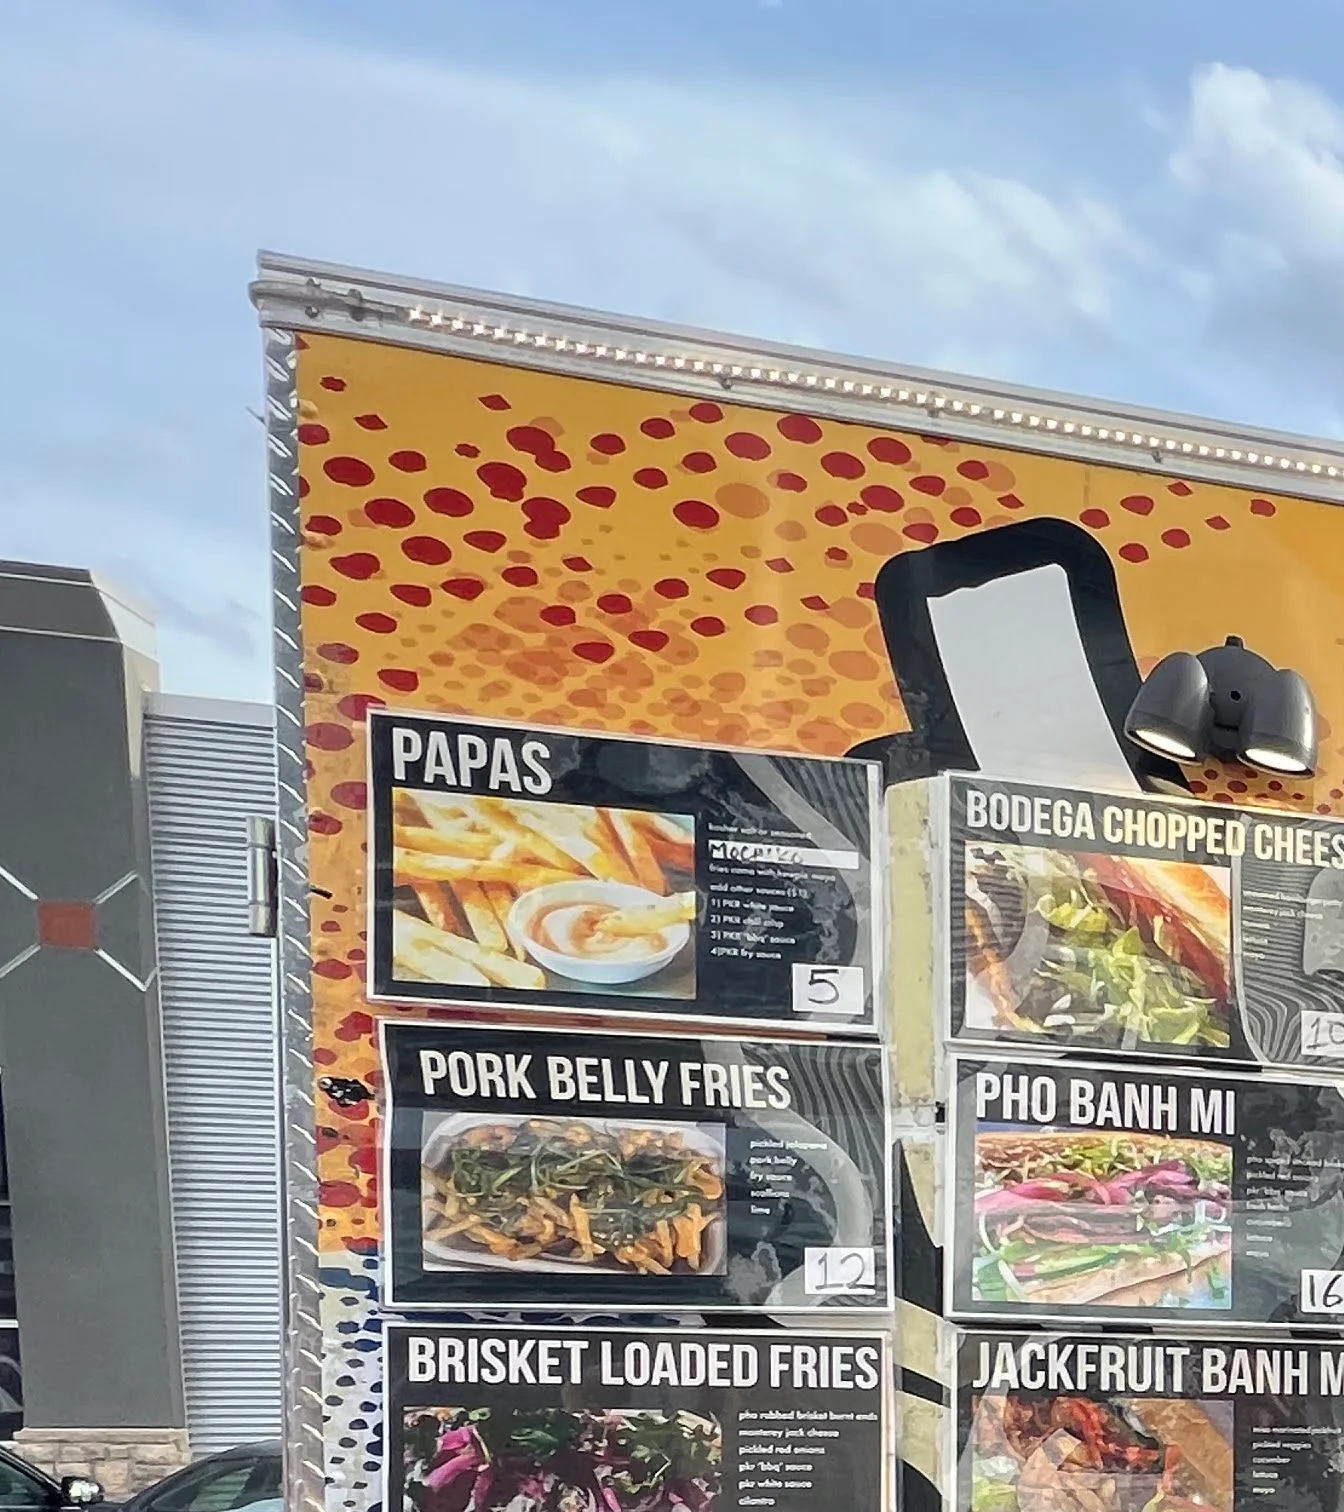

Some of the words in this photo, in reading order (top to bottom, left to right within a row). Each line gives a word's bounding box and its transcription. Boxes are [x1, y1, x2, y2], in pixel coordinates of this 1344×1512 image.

[392, 726, 553, 795] PAPAS
[965, 789, 1095, 841] BODEGA
[1103, 805, 1246, 856] CHOPPED
[808, 969, 839, 1004] 5
[419, 1049, 536, 1100] PORK
[548, 1055, 668, 1106] BELLY
[681, 1062, 792, 1110] FRIES
[975, 1072, 1057, 1123] PHO
[1069, 1078, 1177, 1132] BANH
[1190, 1087, 1236, 1135] MI
[815, 1252, 875, 1290] 12
[1307, 1274, 1344, 1308] 16
[408, 1336, 589, 1385] BRISKET
[600, 1340, 758, 1387] LOADED
[769, 1345, 879, 1390] FRIES
[972, 1341, 1191, 1393] JACKFRUIT
[1202, 1348, 1308, 1395] BANH
[760, 1410, 795, 1420] rubbed
[796, 1410, 828, 1420] brisket
[738, 1445, 774, 1455] pickled
[775, 1445, 791, 1454] red
[758, 1479, 783, 1488] white
